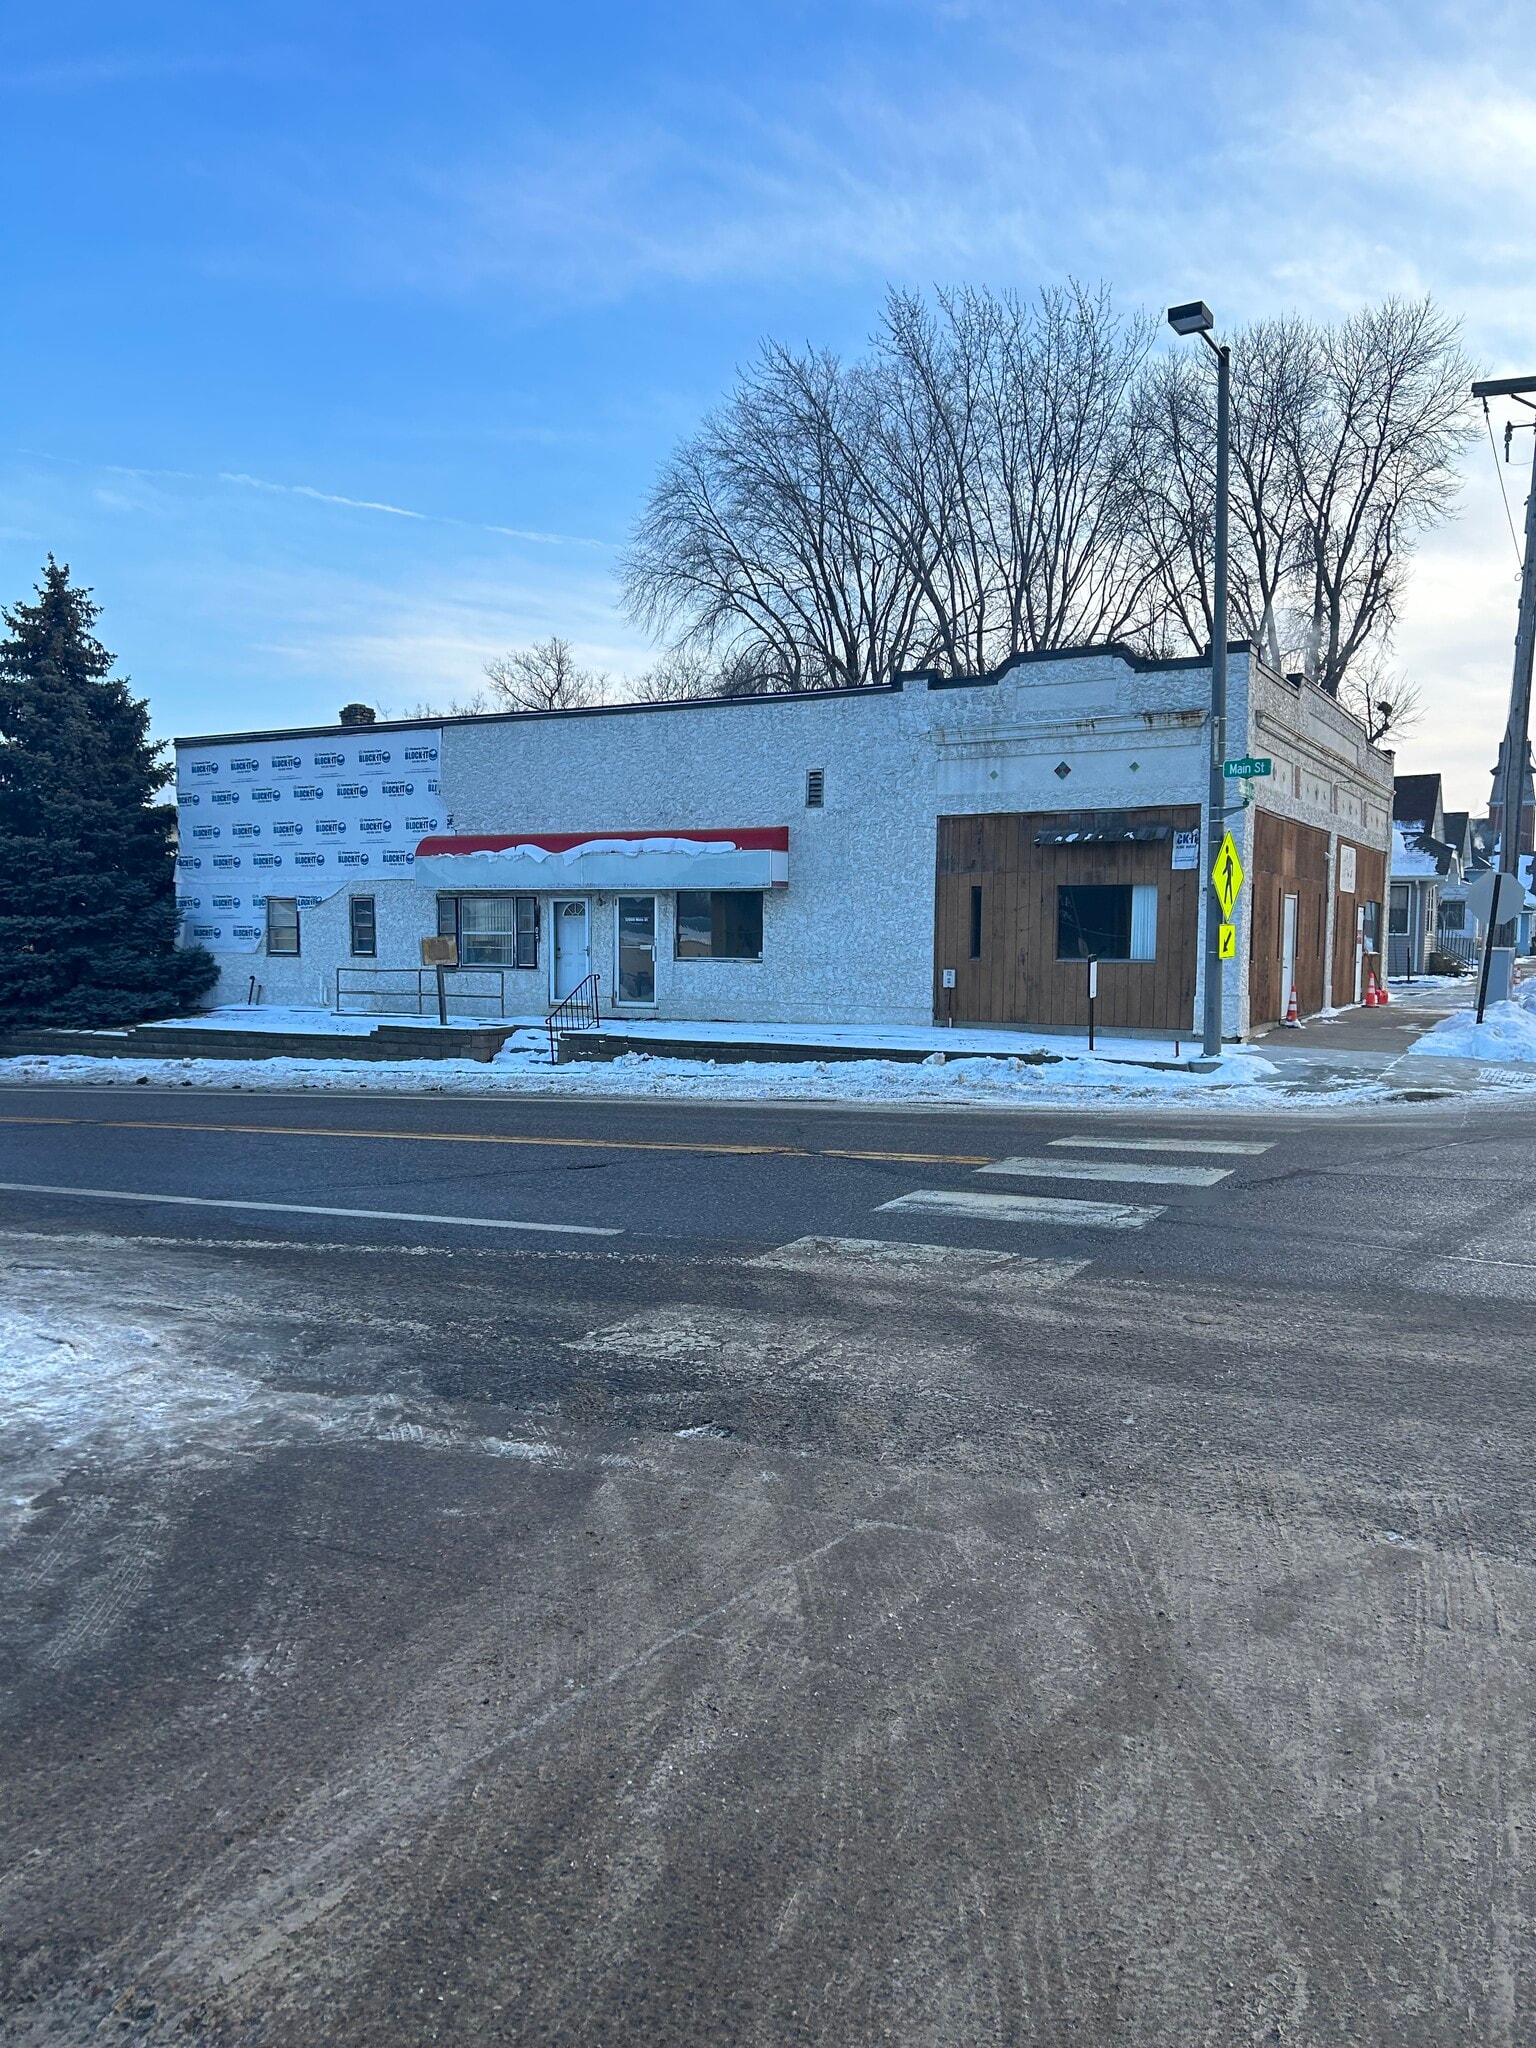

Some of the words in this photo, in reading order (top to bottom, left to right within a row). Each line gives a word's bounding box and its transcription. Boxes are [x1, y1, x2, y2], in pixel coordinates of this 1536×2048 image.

[405, 751, 429, 760] BLOCK-IT
[1229, 763, 1251, 775] Main
[1254, 762, 1265, 773] St
[405, 821, 429, 830] BLOCK-IT
[383, 854, 405, 863] BLOCK-IT
